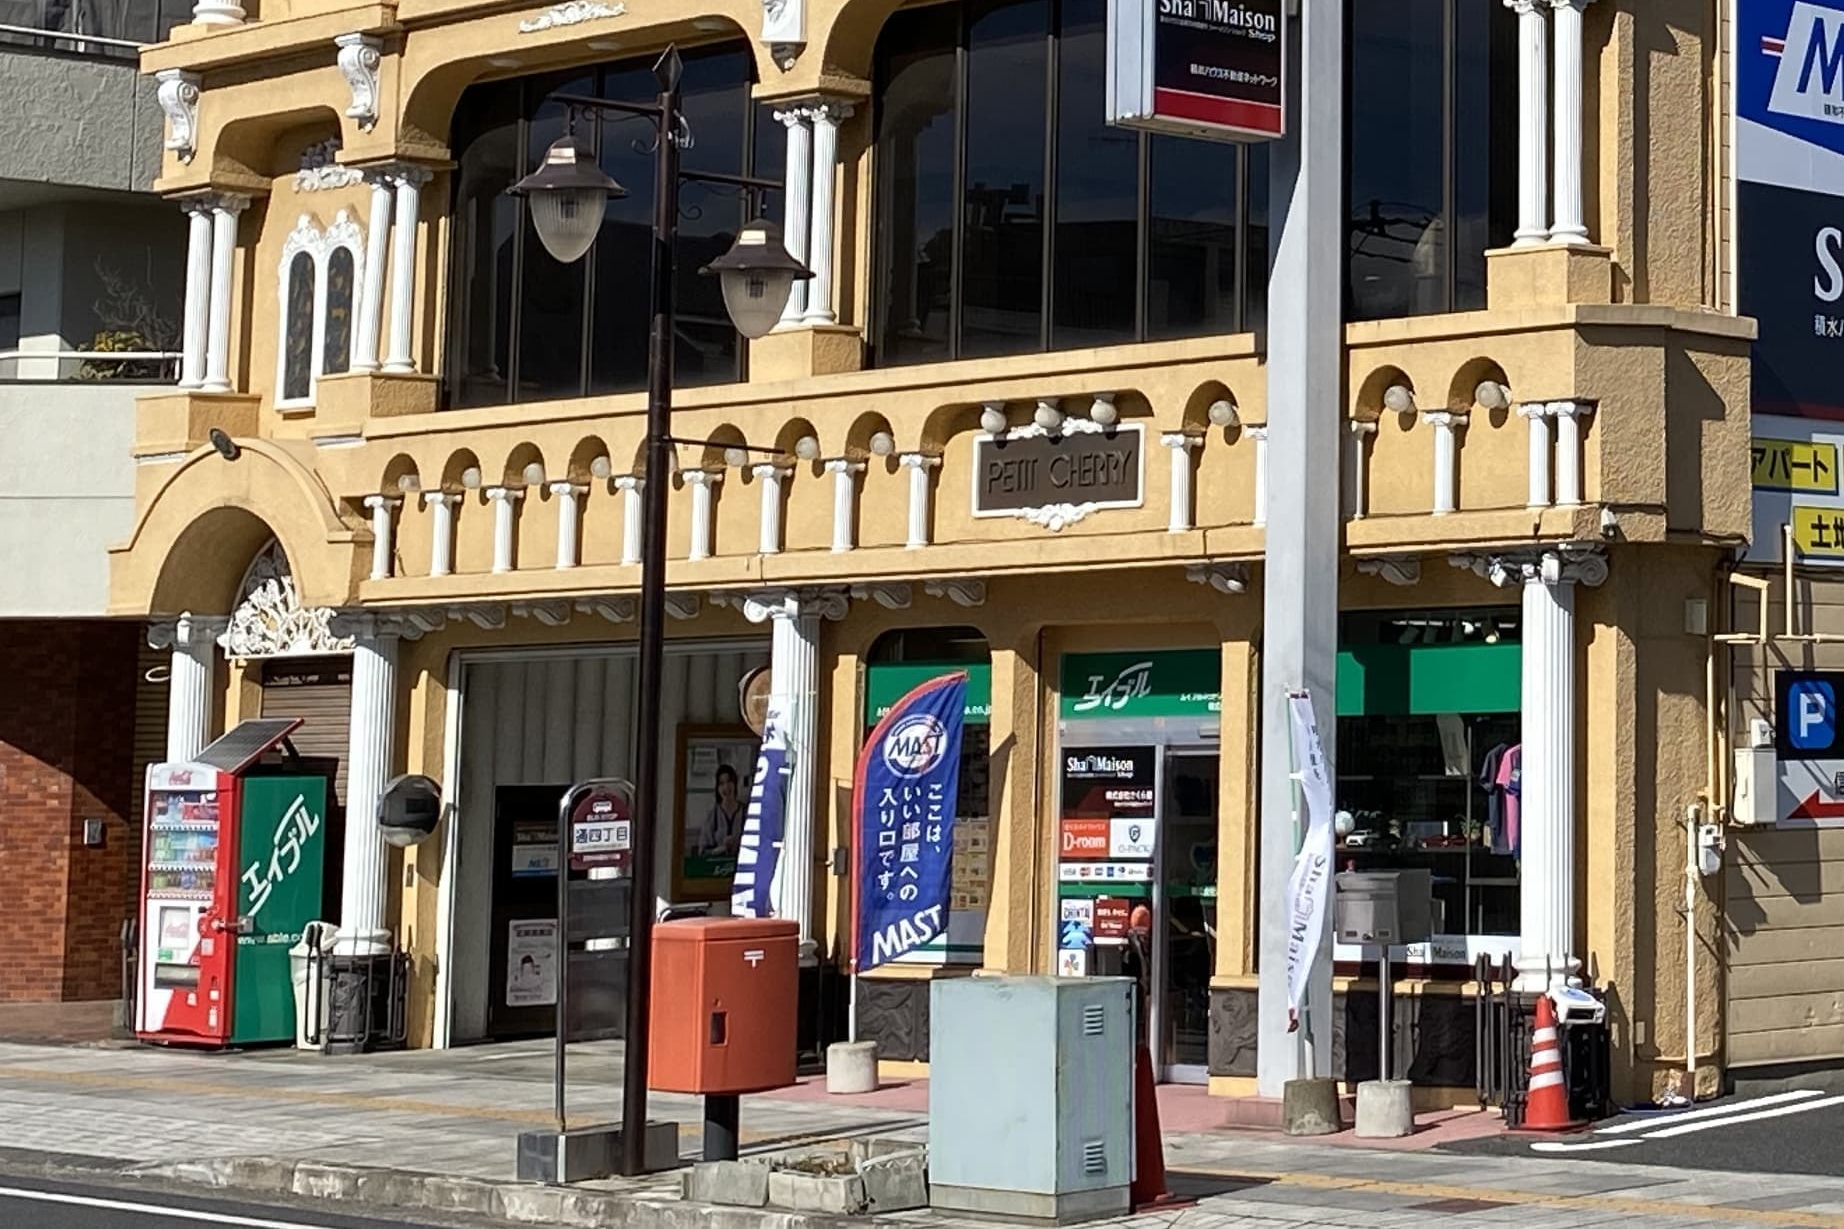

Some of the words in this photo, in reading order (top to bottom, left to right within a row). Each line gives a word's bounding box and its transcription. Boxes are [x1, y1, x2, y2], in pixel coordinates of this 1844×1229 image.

[1213, 0, 1276, 32] Maison
[1750, 447, 1828, 483] アパート
[1074, 661, 1153, 711] エイブル
[878, 788, 898, 901] 入り口です。
[899, 786, 921, 901] いい部屋への
[926, 783, 943, 853] ここは、
[1063, 832, 1106, 851] D-room
[242, 793, 320, 917] エイブル
[872, 904, 942, 965] MAST
